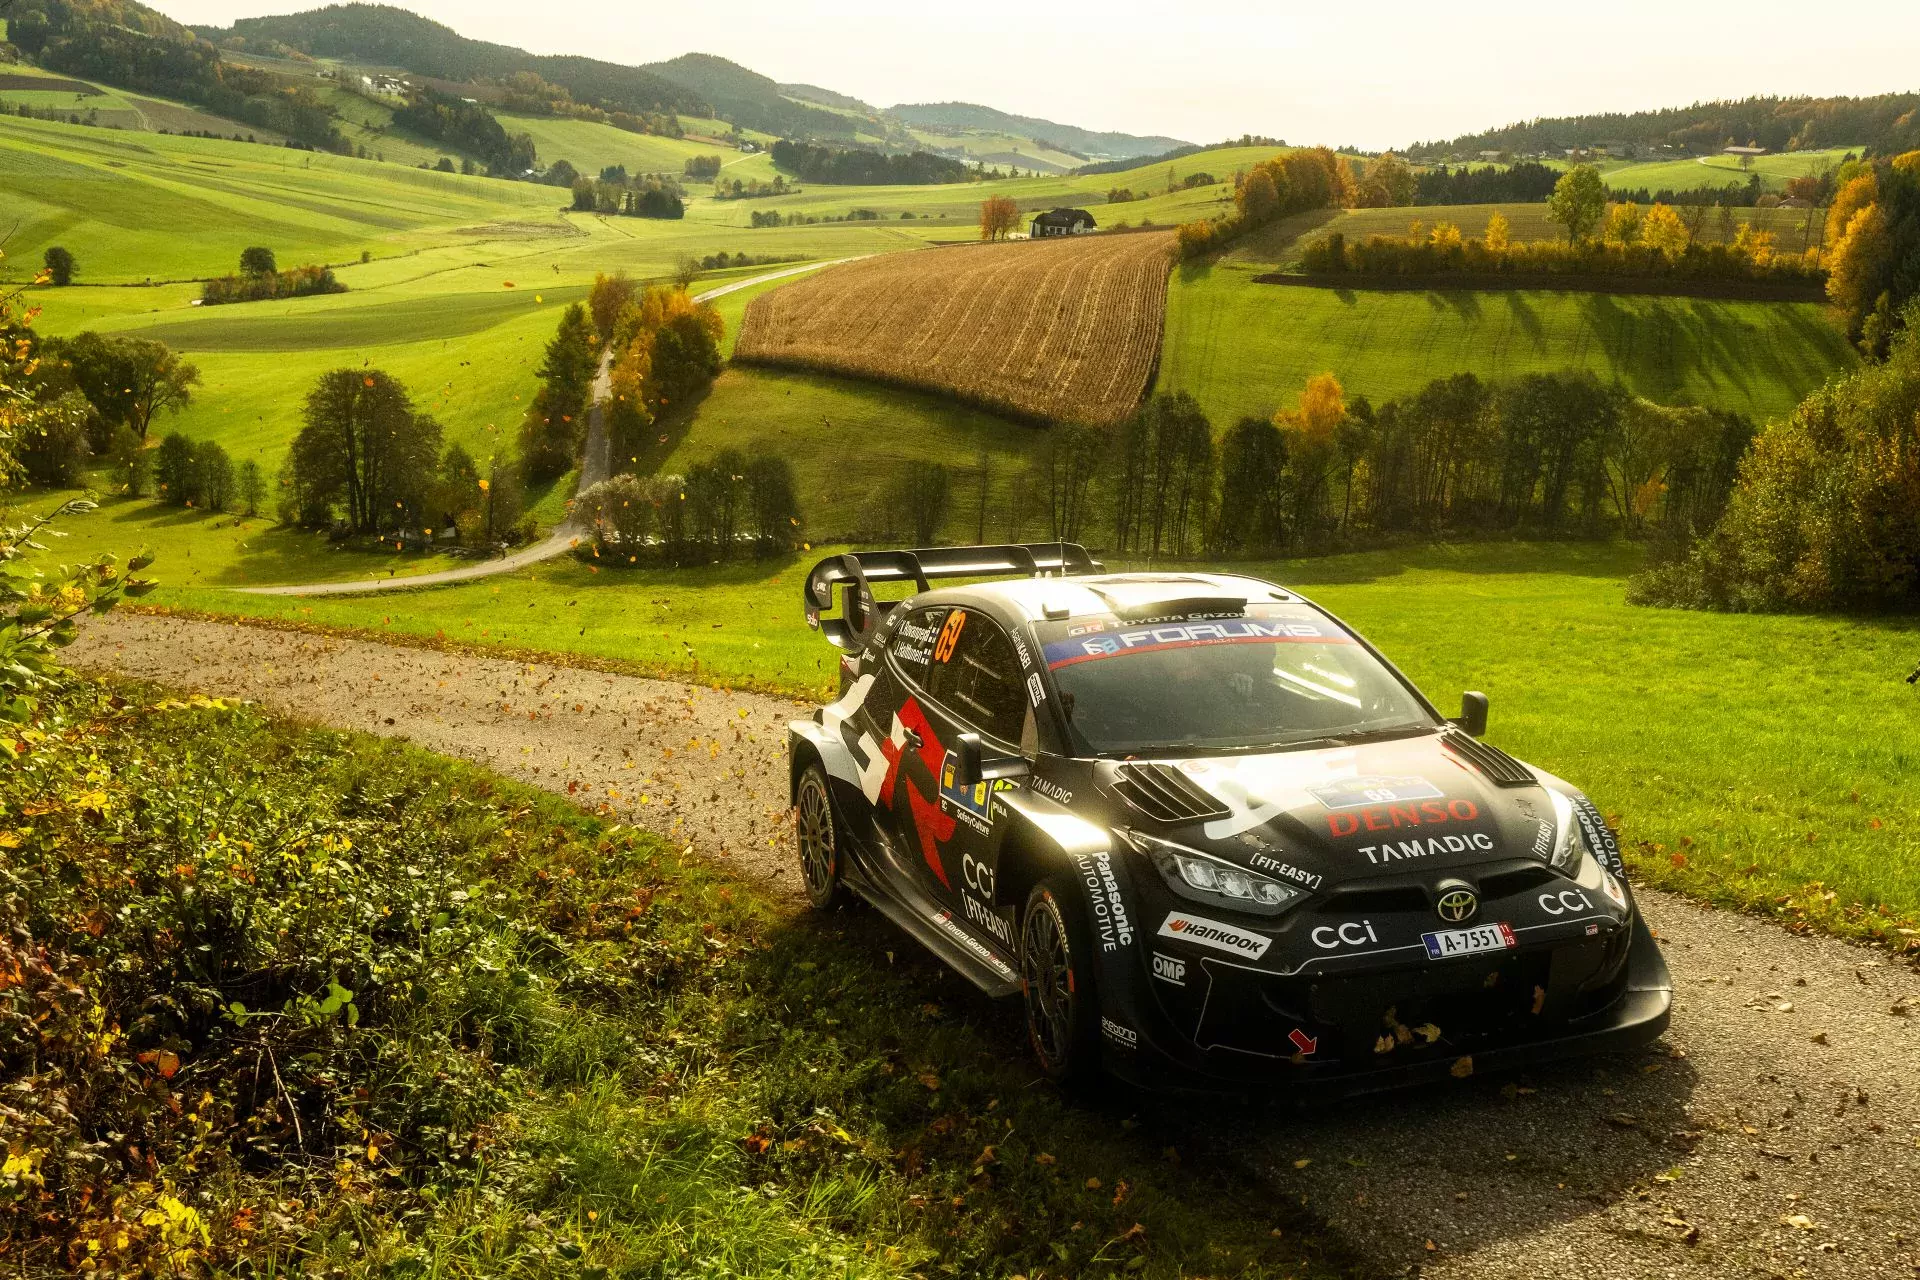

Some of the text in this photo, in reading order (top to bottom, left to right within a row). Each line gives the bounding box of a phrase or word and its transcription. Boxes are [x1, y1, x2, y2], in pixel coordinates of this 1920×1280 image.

[1107, 614, 1184, 628] TOYOTA
[934, 609, 967, 663] 69
[1119, 623, 1322, 647] FORUM8
[1031, 775, 1073, 804] TAMADIC
[1363, 787, 1397, 801] 69
[1324, 799, 1479, 838] DENSO
[1358, 833, 1494, 864] TAMADIC
[1074, 853, 1117, 953] AUTOMOTIVE
[1091, 851, 1134, 946] Panasonic
[944, 920, 969, 941] TOYOTA
[967, 938, 991, 957] GAZOO
[1444, 929, 1499, 952] A-7551
[1500, 924, 1509, 933] 11
[1504, 935, 1515, 945] 25
[1153, 956, 1186, 981] OMP
